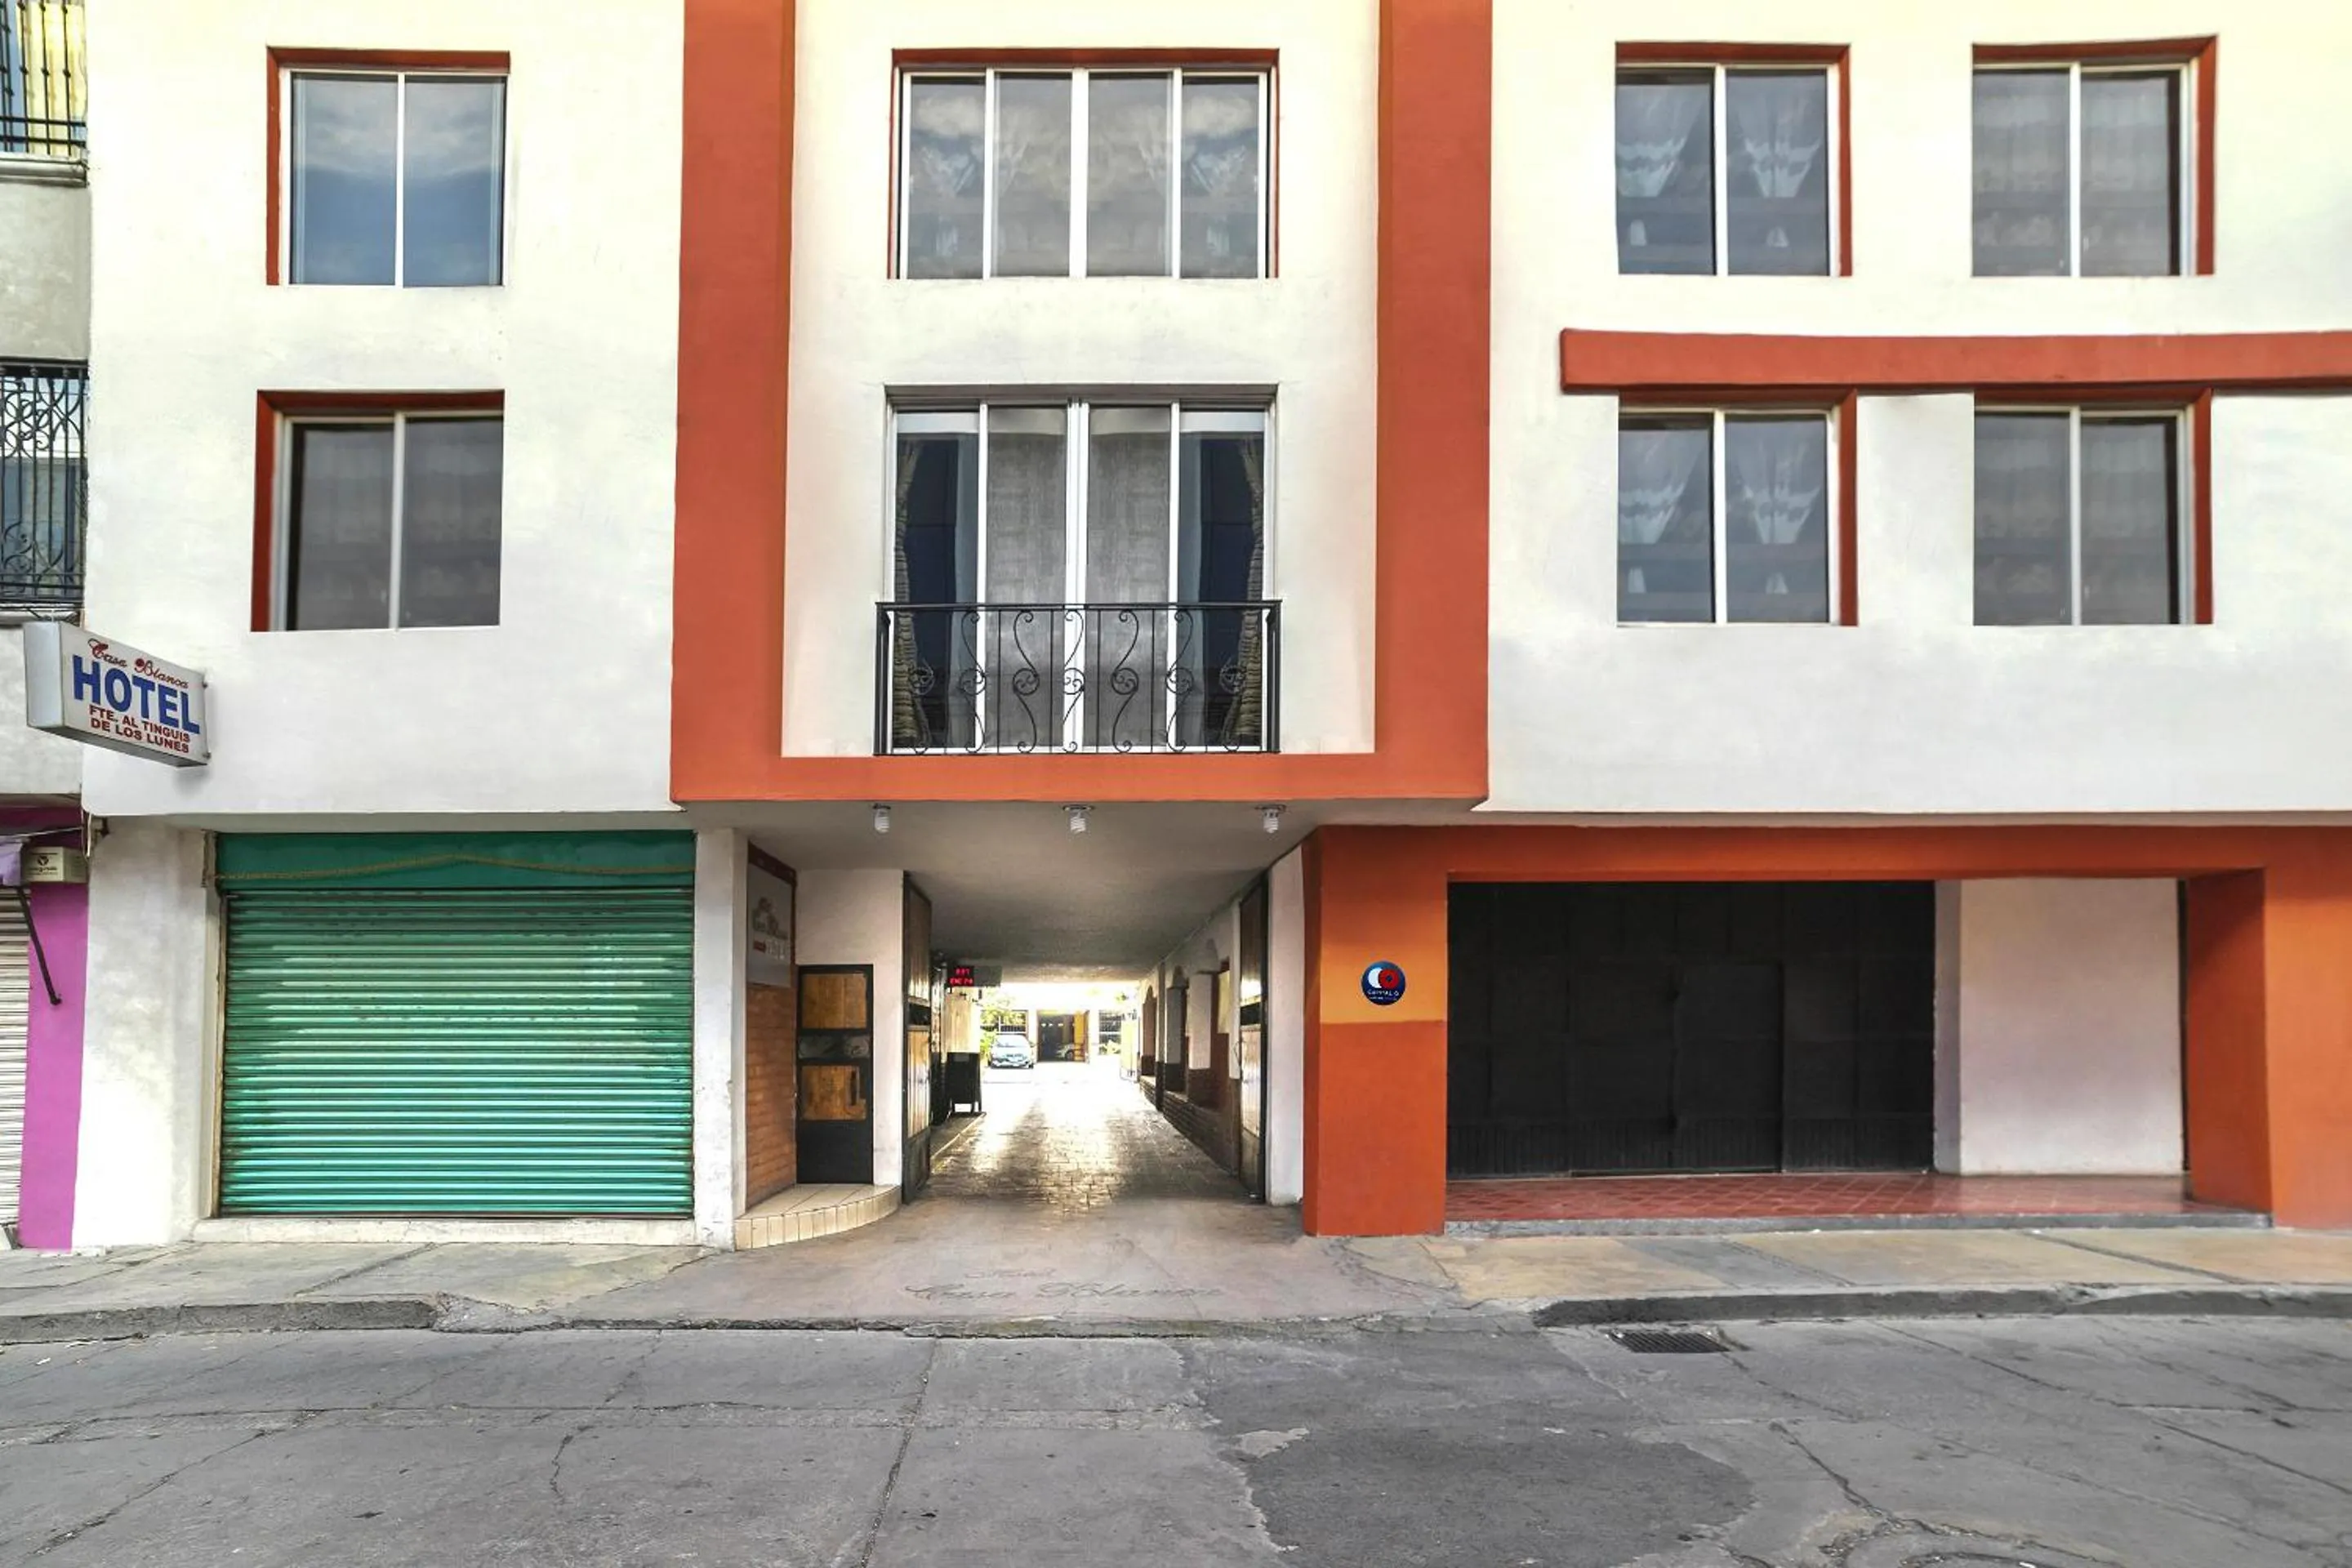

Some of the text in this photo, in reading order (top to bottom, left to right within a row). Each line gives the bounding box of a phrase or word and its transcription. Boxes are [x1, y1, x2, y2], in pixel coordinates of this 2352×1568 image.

[88, 638, 189, 688] Casa Blanca
[73, 654, 200, 734] HOTEL
[89, 704, 190, 742] FTE. AL TINGUIS
[91, 718, 189, 753] DE LOS LUNES
